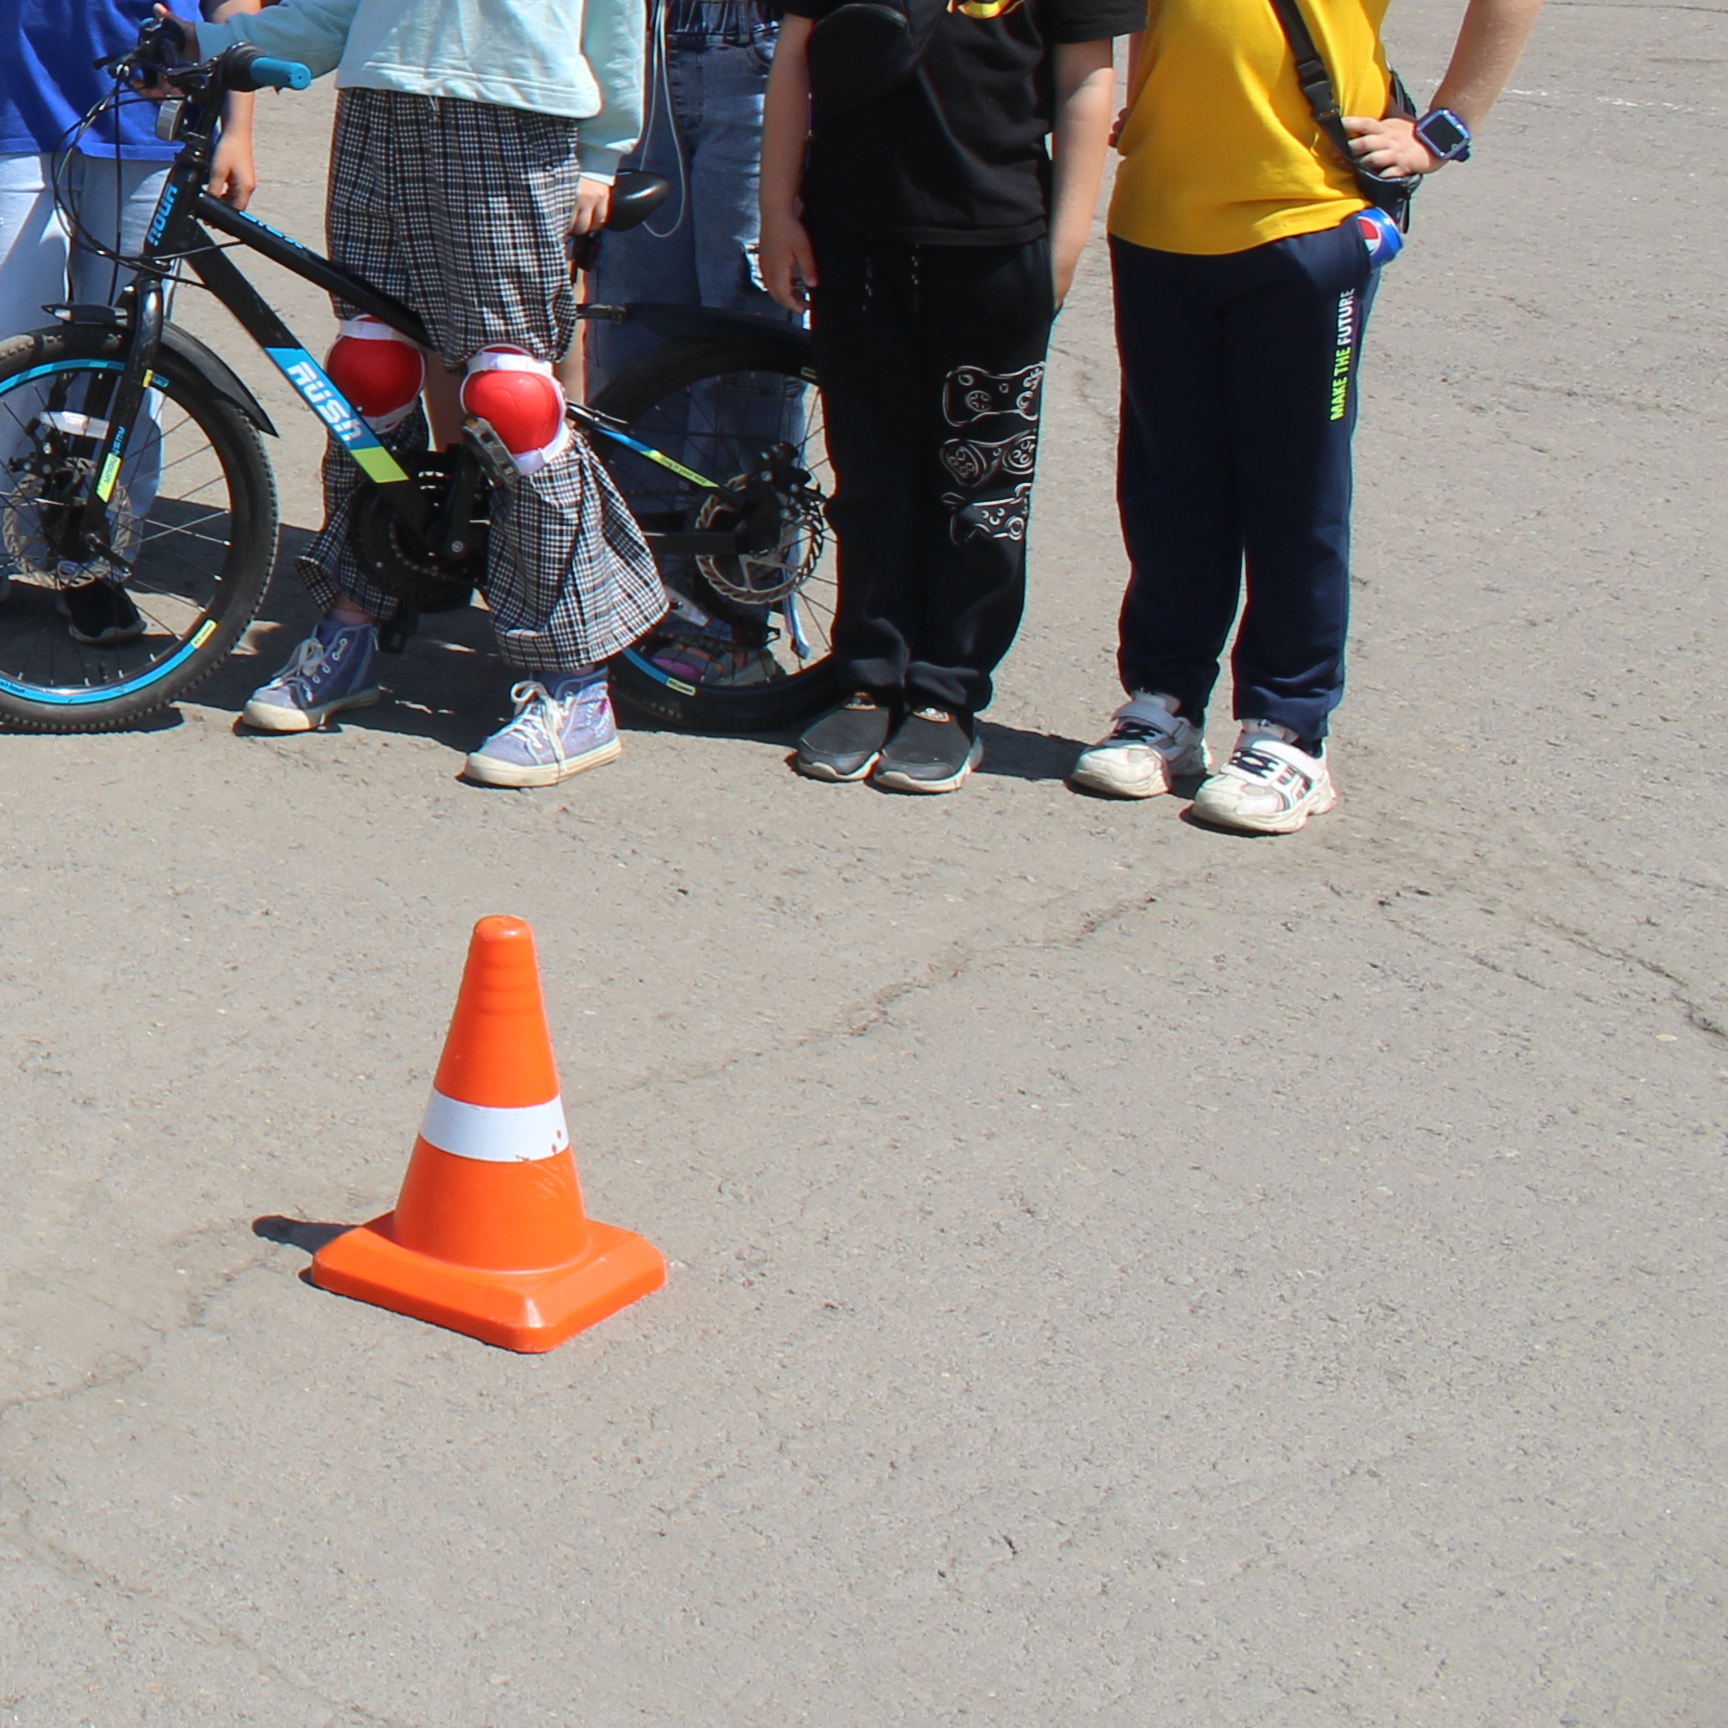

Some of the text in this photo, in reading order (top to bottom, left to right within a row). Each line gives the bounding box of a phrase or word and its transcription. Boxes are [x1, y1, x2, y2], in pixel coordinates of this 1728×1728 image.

[1330, 287, 1355, 421] MAKE THE FUTURE
